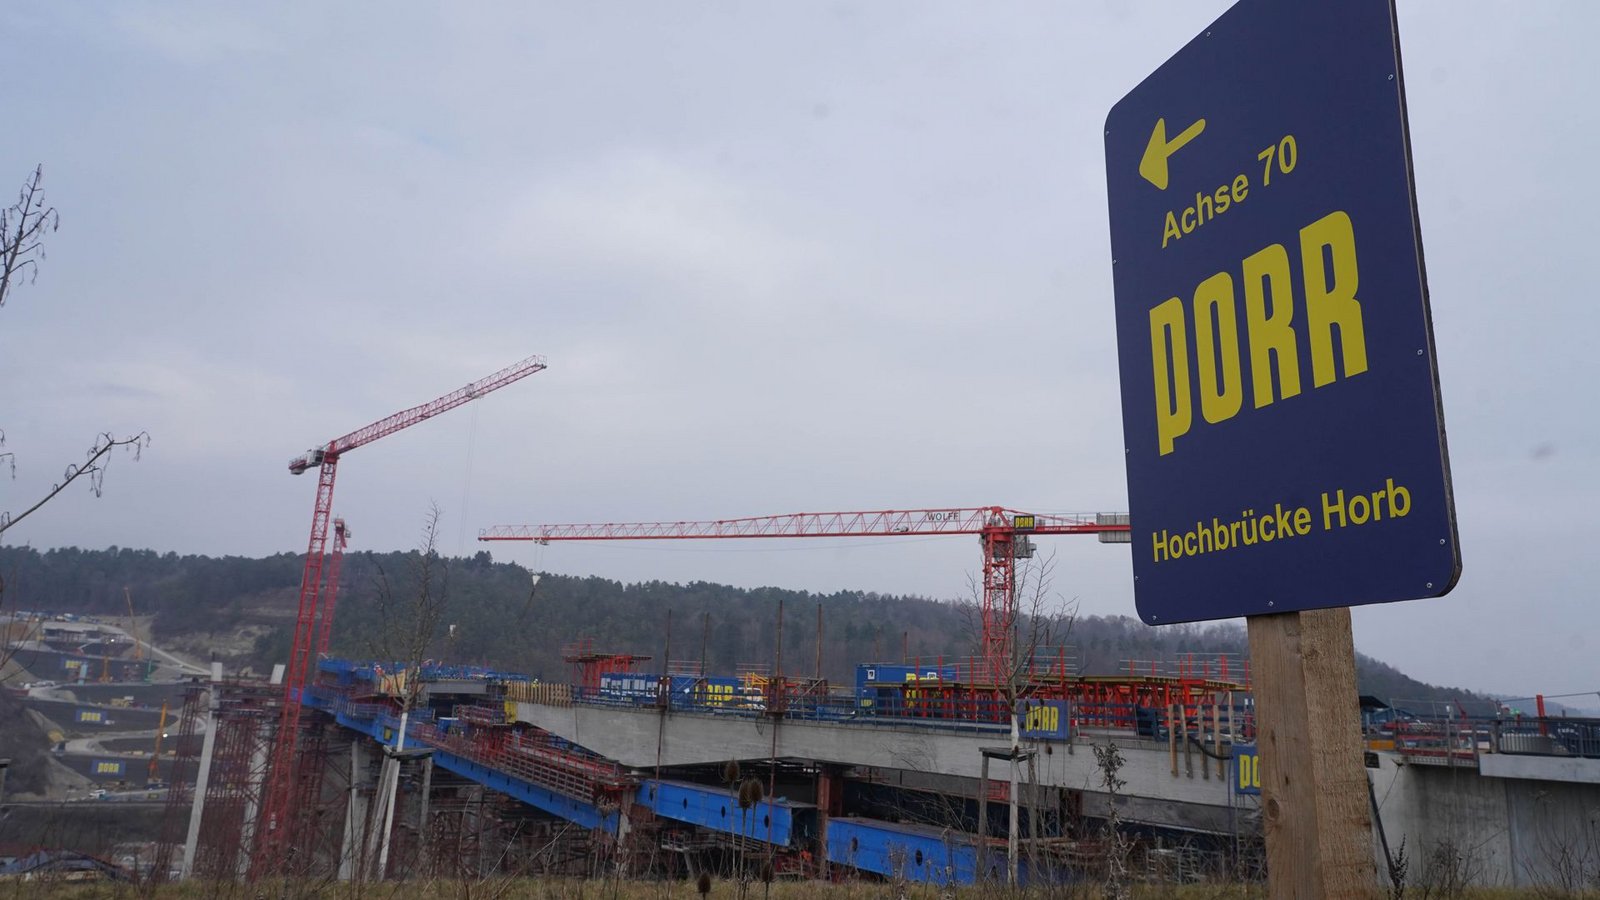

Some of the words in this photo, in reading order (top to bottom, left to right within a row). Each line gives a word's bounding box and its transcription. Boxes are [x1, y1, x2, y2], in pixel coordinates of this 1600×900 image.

[1160, 173, 1250, 249] Achse
[1257, 134, 1298, 187] 70
[1149, 210, 1369, 456] PORR
[927, 512, 959, 521] WOLFF
[1152, 504, 1312, 563] Hochbrücke
[1321, 478, 1412, 532] Horb
[1026, 705, 1059, 732] PORR
